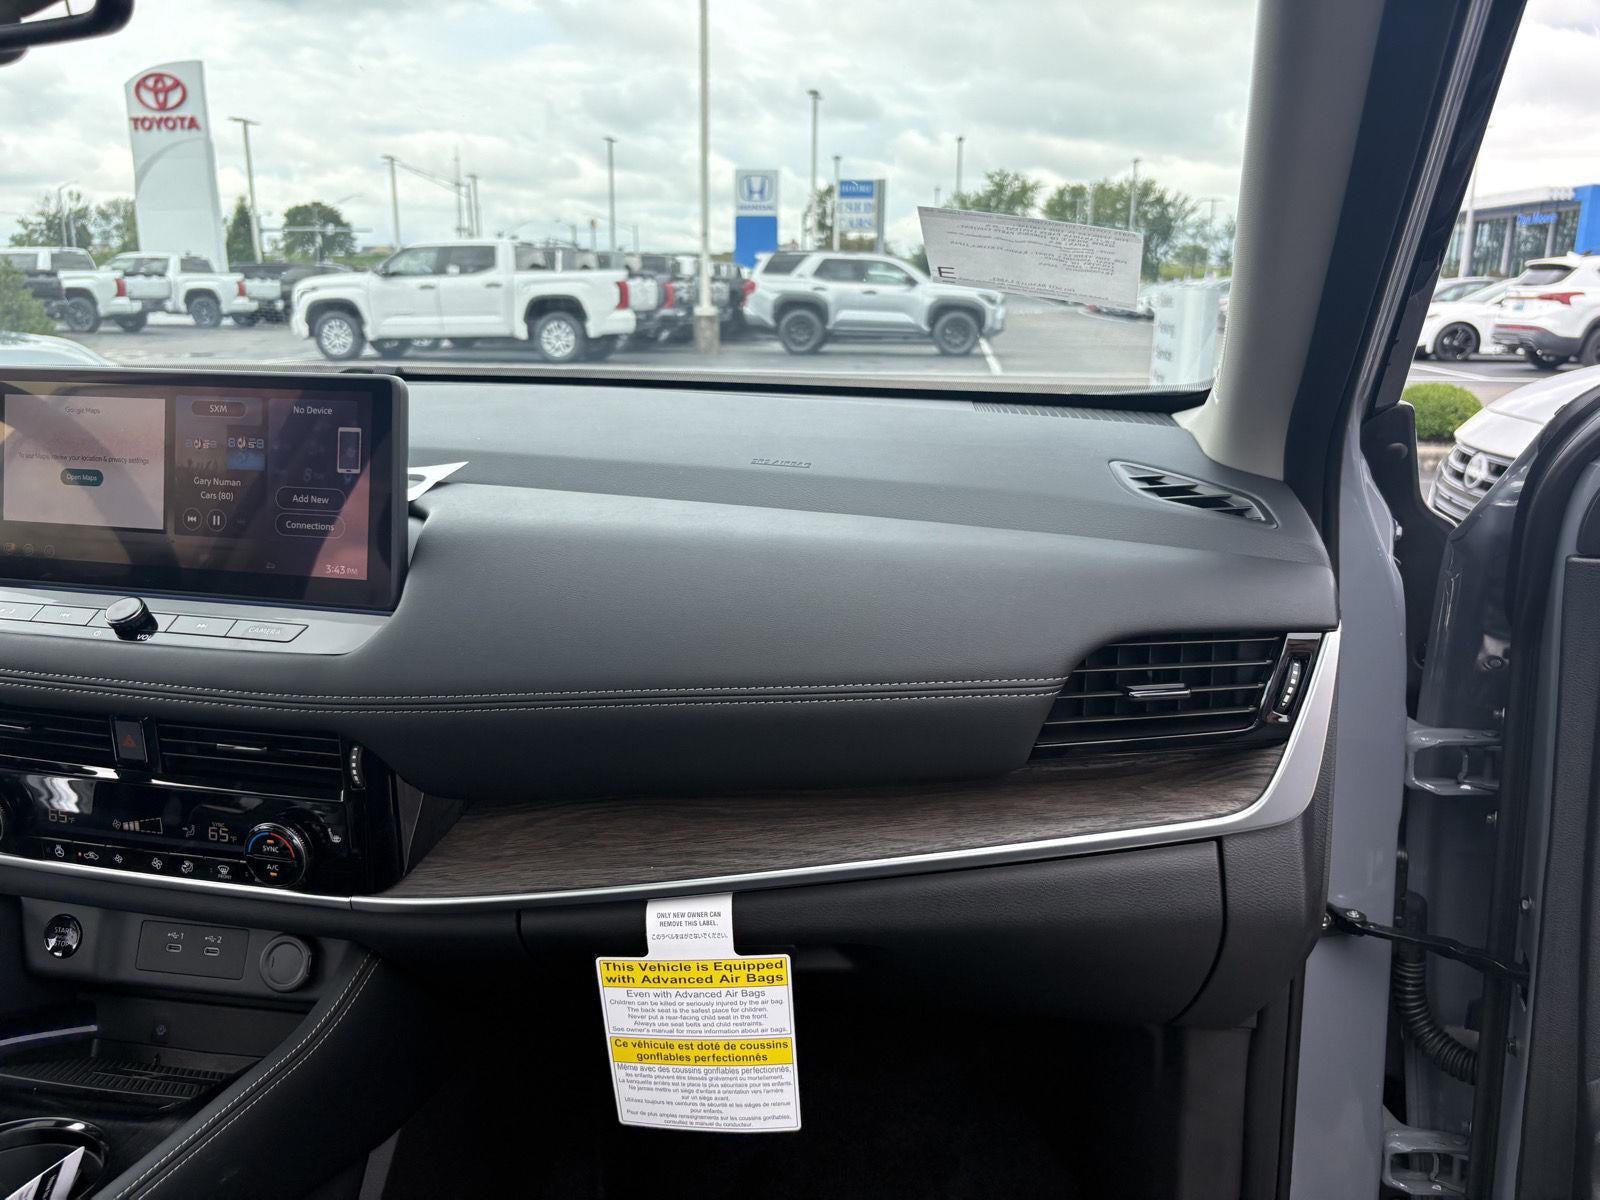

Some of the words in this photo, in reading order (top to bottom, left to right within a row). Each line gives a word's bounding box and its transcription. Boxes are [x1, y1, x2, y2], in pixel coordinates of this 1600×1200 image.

[130, 116, 201, 131] TOYOTA
[210, 404, 228, 413] SXM
[293, 406, 304, 414] No
[308, 406, 332, 414] Device
[66, 473, 82, 482] Open
[82, 474, 98, 482] Maps
[194, 477, 212, 487] Gary
[213, 478, 242, 486] Numan
[200, 492, 216, 500] Cars
[218, 491, 234, 501] (80)
[292, 494, 308, 502] Add
[310, 496, 329, 504] New
[286, 520, 334, 531] Connections
[326, 564, 346, 574] 3:43
[262, 845, 279, 853] SYNC
[603, 962, 634, 972] This
[638, 962, 692, 972] Vehicle
[696, 962, 708, 971] is
[714, 960, 783, 972] Equipped
[606, 975, 635, 983] with
[641, 975, 713, 984] Advanced
[720, 974, 740, 983] Air
[746, 974, 784, 984] Bags
[626, 990, 650, 998] Even
[675, 990, 722, 998] Advanced
[741, 990, 766, 999] Bags
[615, 1039, 628, 1047] Ce
[631, 1040, 674, 1049] véhicule
[678, 1042, 694, 1050] est
[697, 1042, 720, 1050] doté
[724, 1042, 736, 1050] de
[740, 1040, 788, 1050] coussins
[637, 1052, 691, 1061] gonflables
[694, 1054, 768, 1063] perfectionnés
[703, 1067, 739, 1075] gonflables
